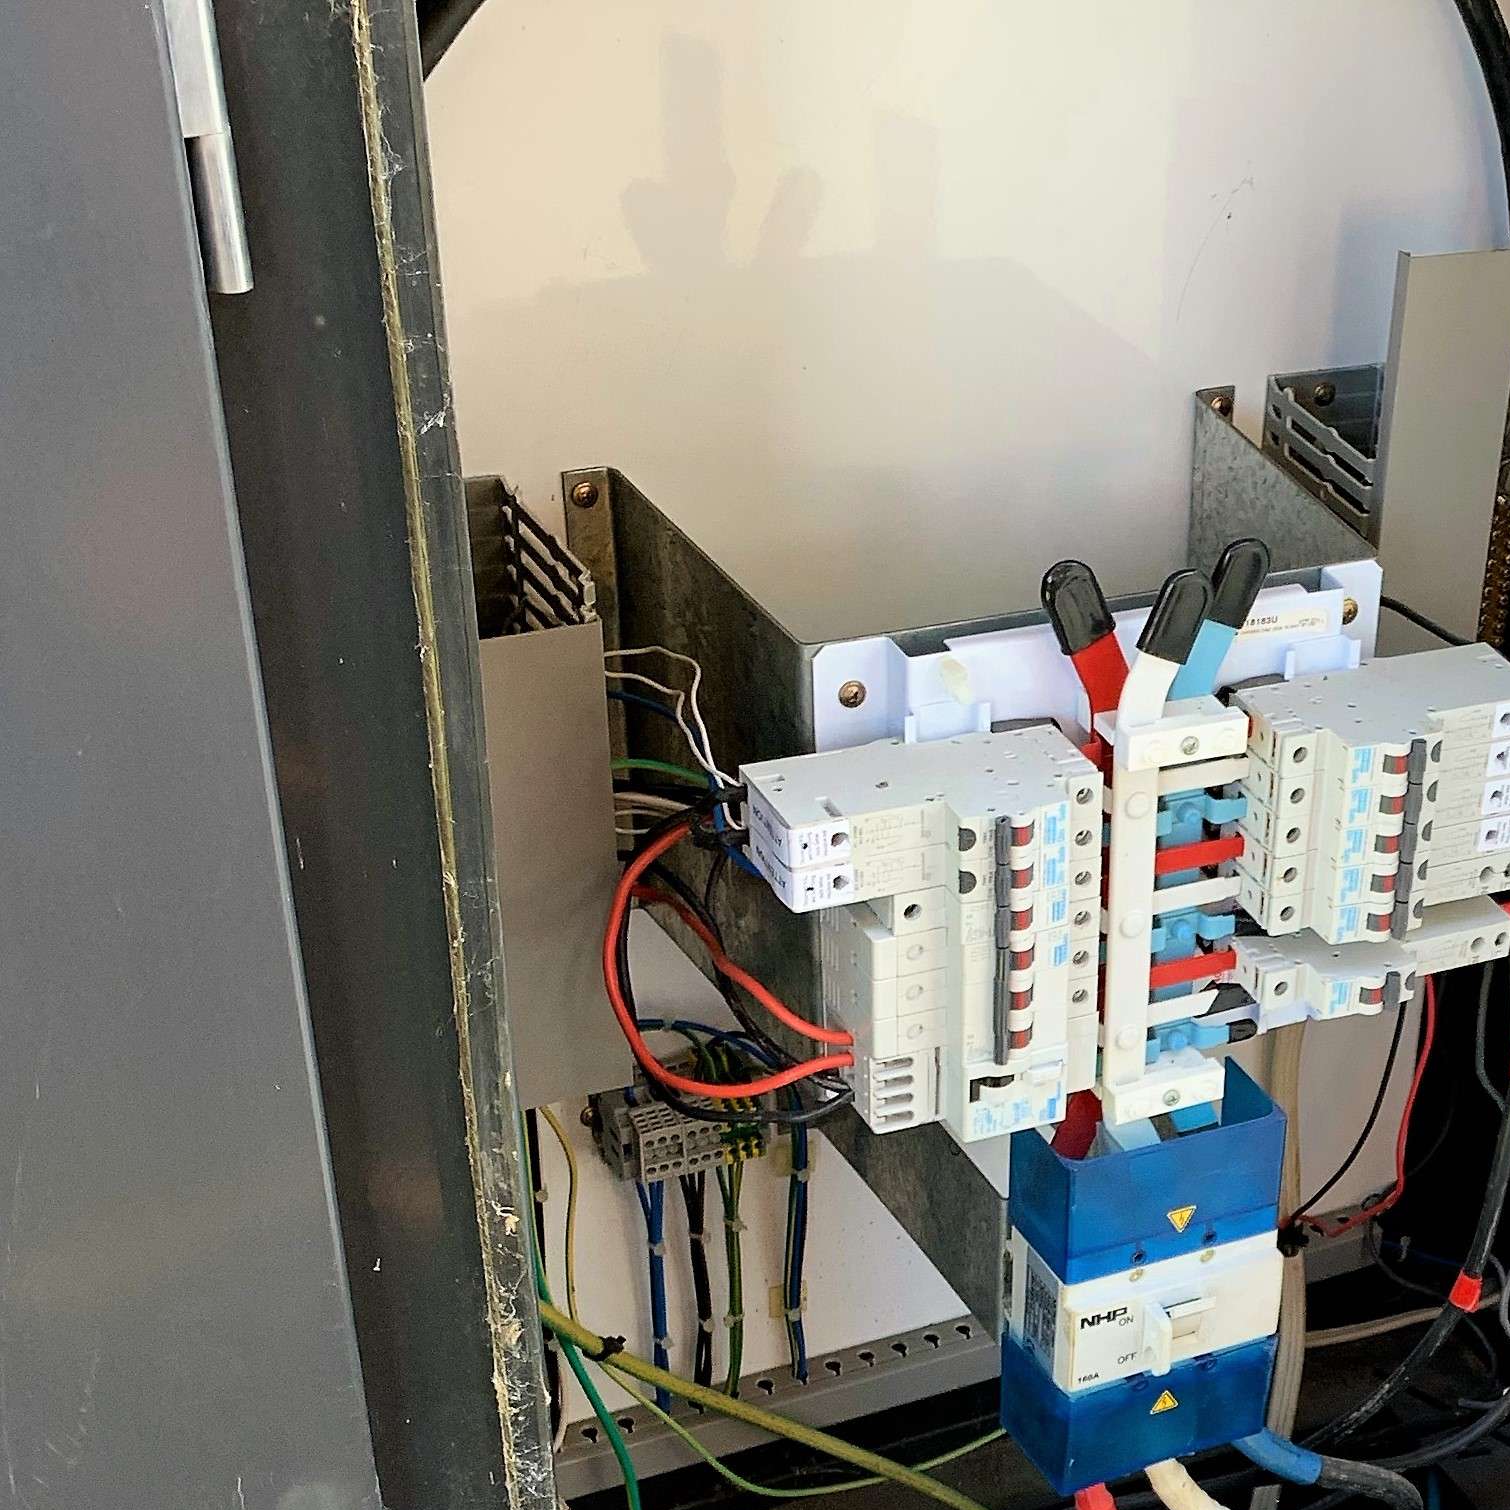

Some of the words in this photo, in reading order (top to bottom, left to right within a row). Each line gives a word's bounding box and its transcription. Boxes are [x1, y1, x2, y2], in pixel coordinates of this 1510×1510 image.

[1080, 1306, 1127, 1330] NHP
[1118, 1315, 1134, 1327] ON
[1117, 1352, 1137, 1365] OFF
